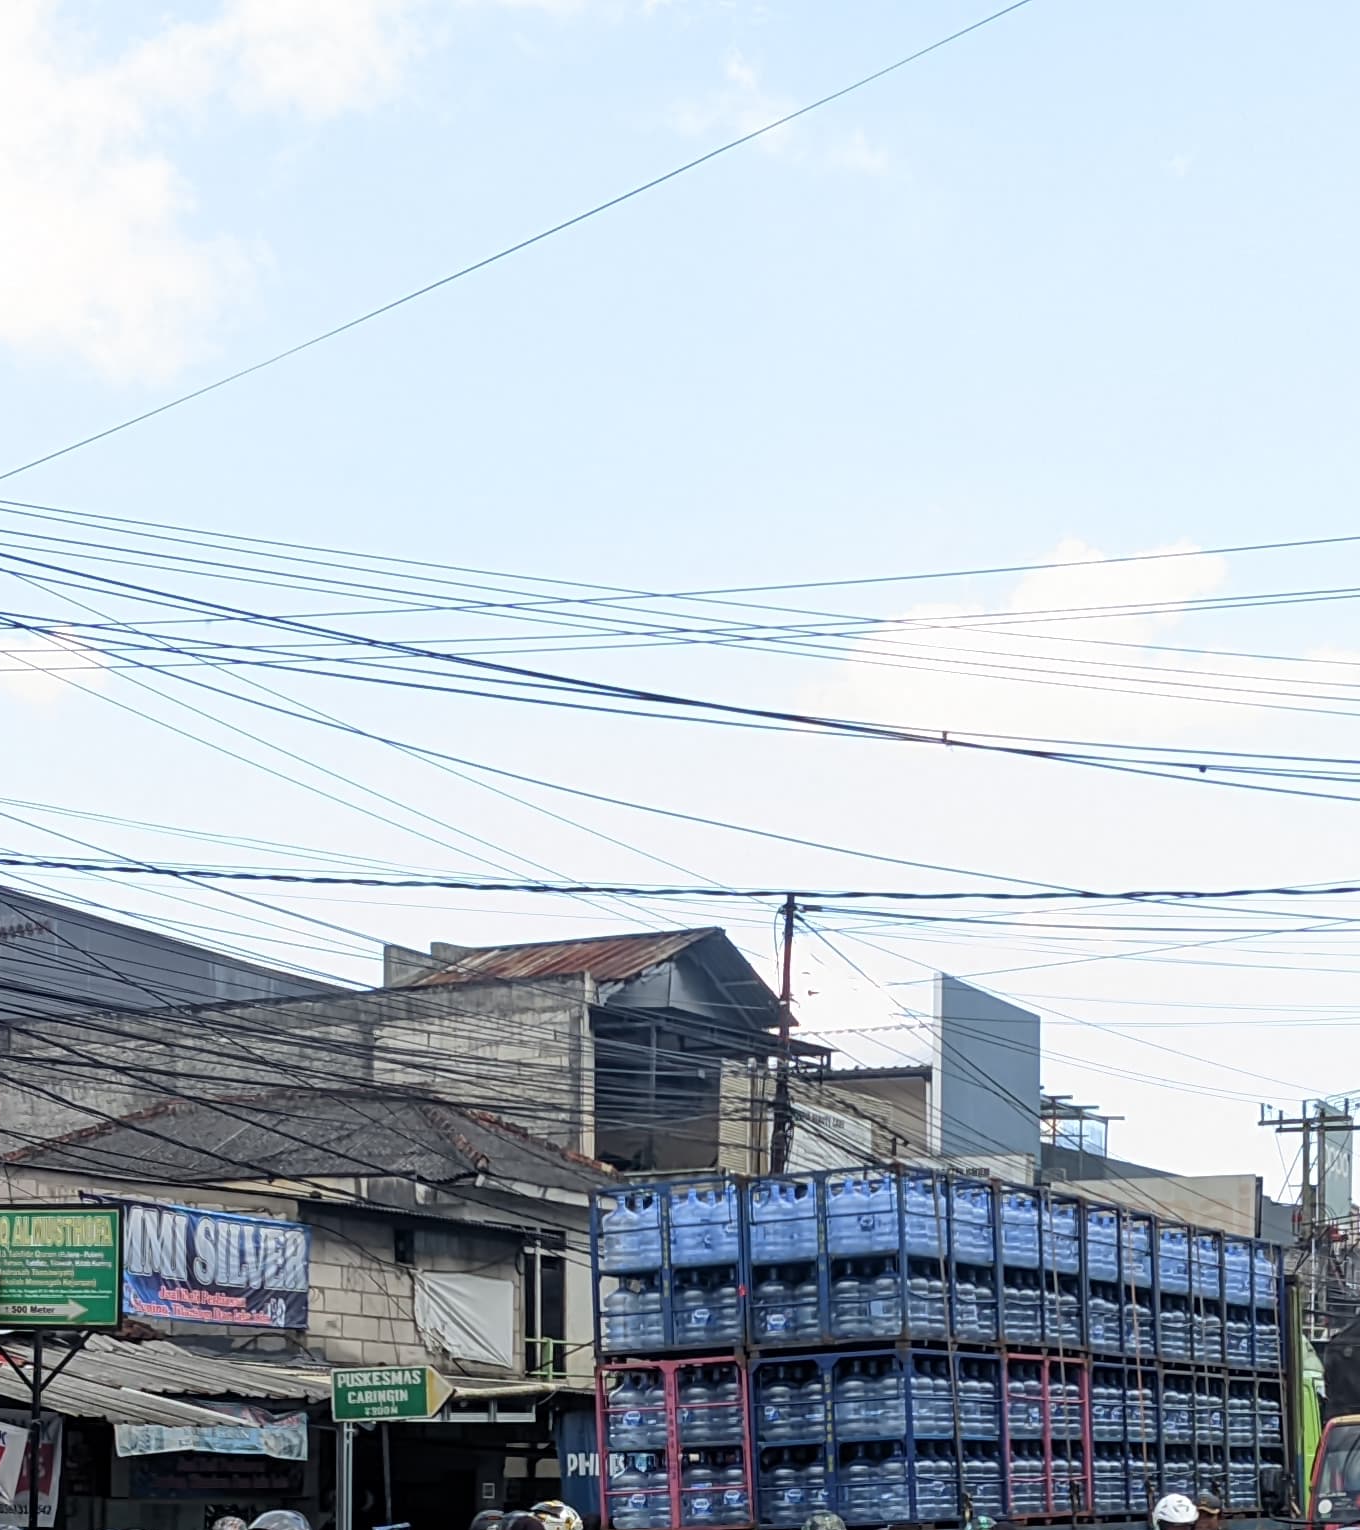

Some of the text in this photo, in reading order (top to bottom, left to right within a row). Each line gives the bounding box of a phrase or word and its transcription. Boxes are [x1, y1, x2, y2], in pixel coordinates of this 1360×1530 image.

[193, 1216, 309, 1293] SILVER
[29, 1306, 56, 1314] Meter
[337, 1370, 421, 1388] PUSKESMAS
[347, 1389, 408, 1404] CARINGIN
